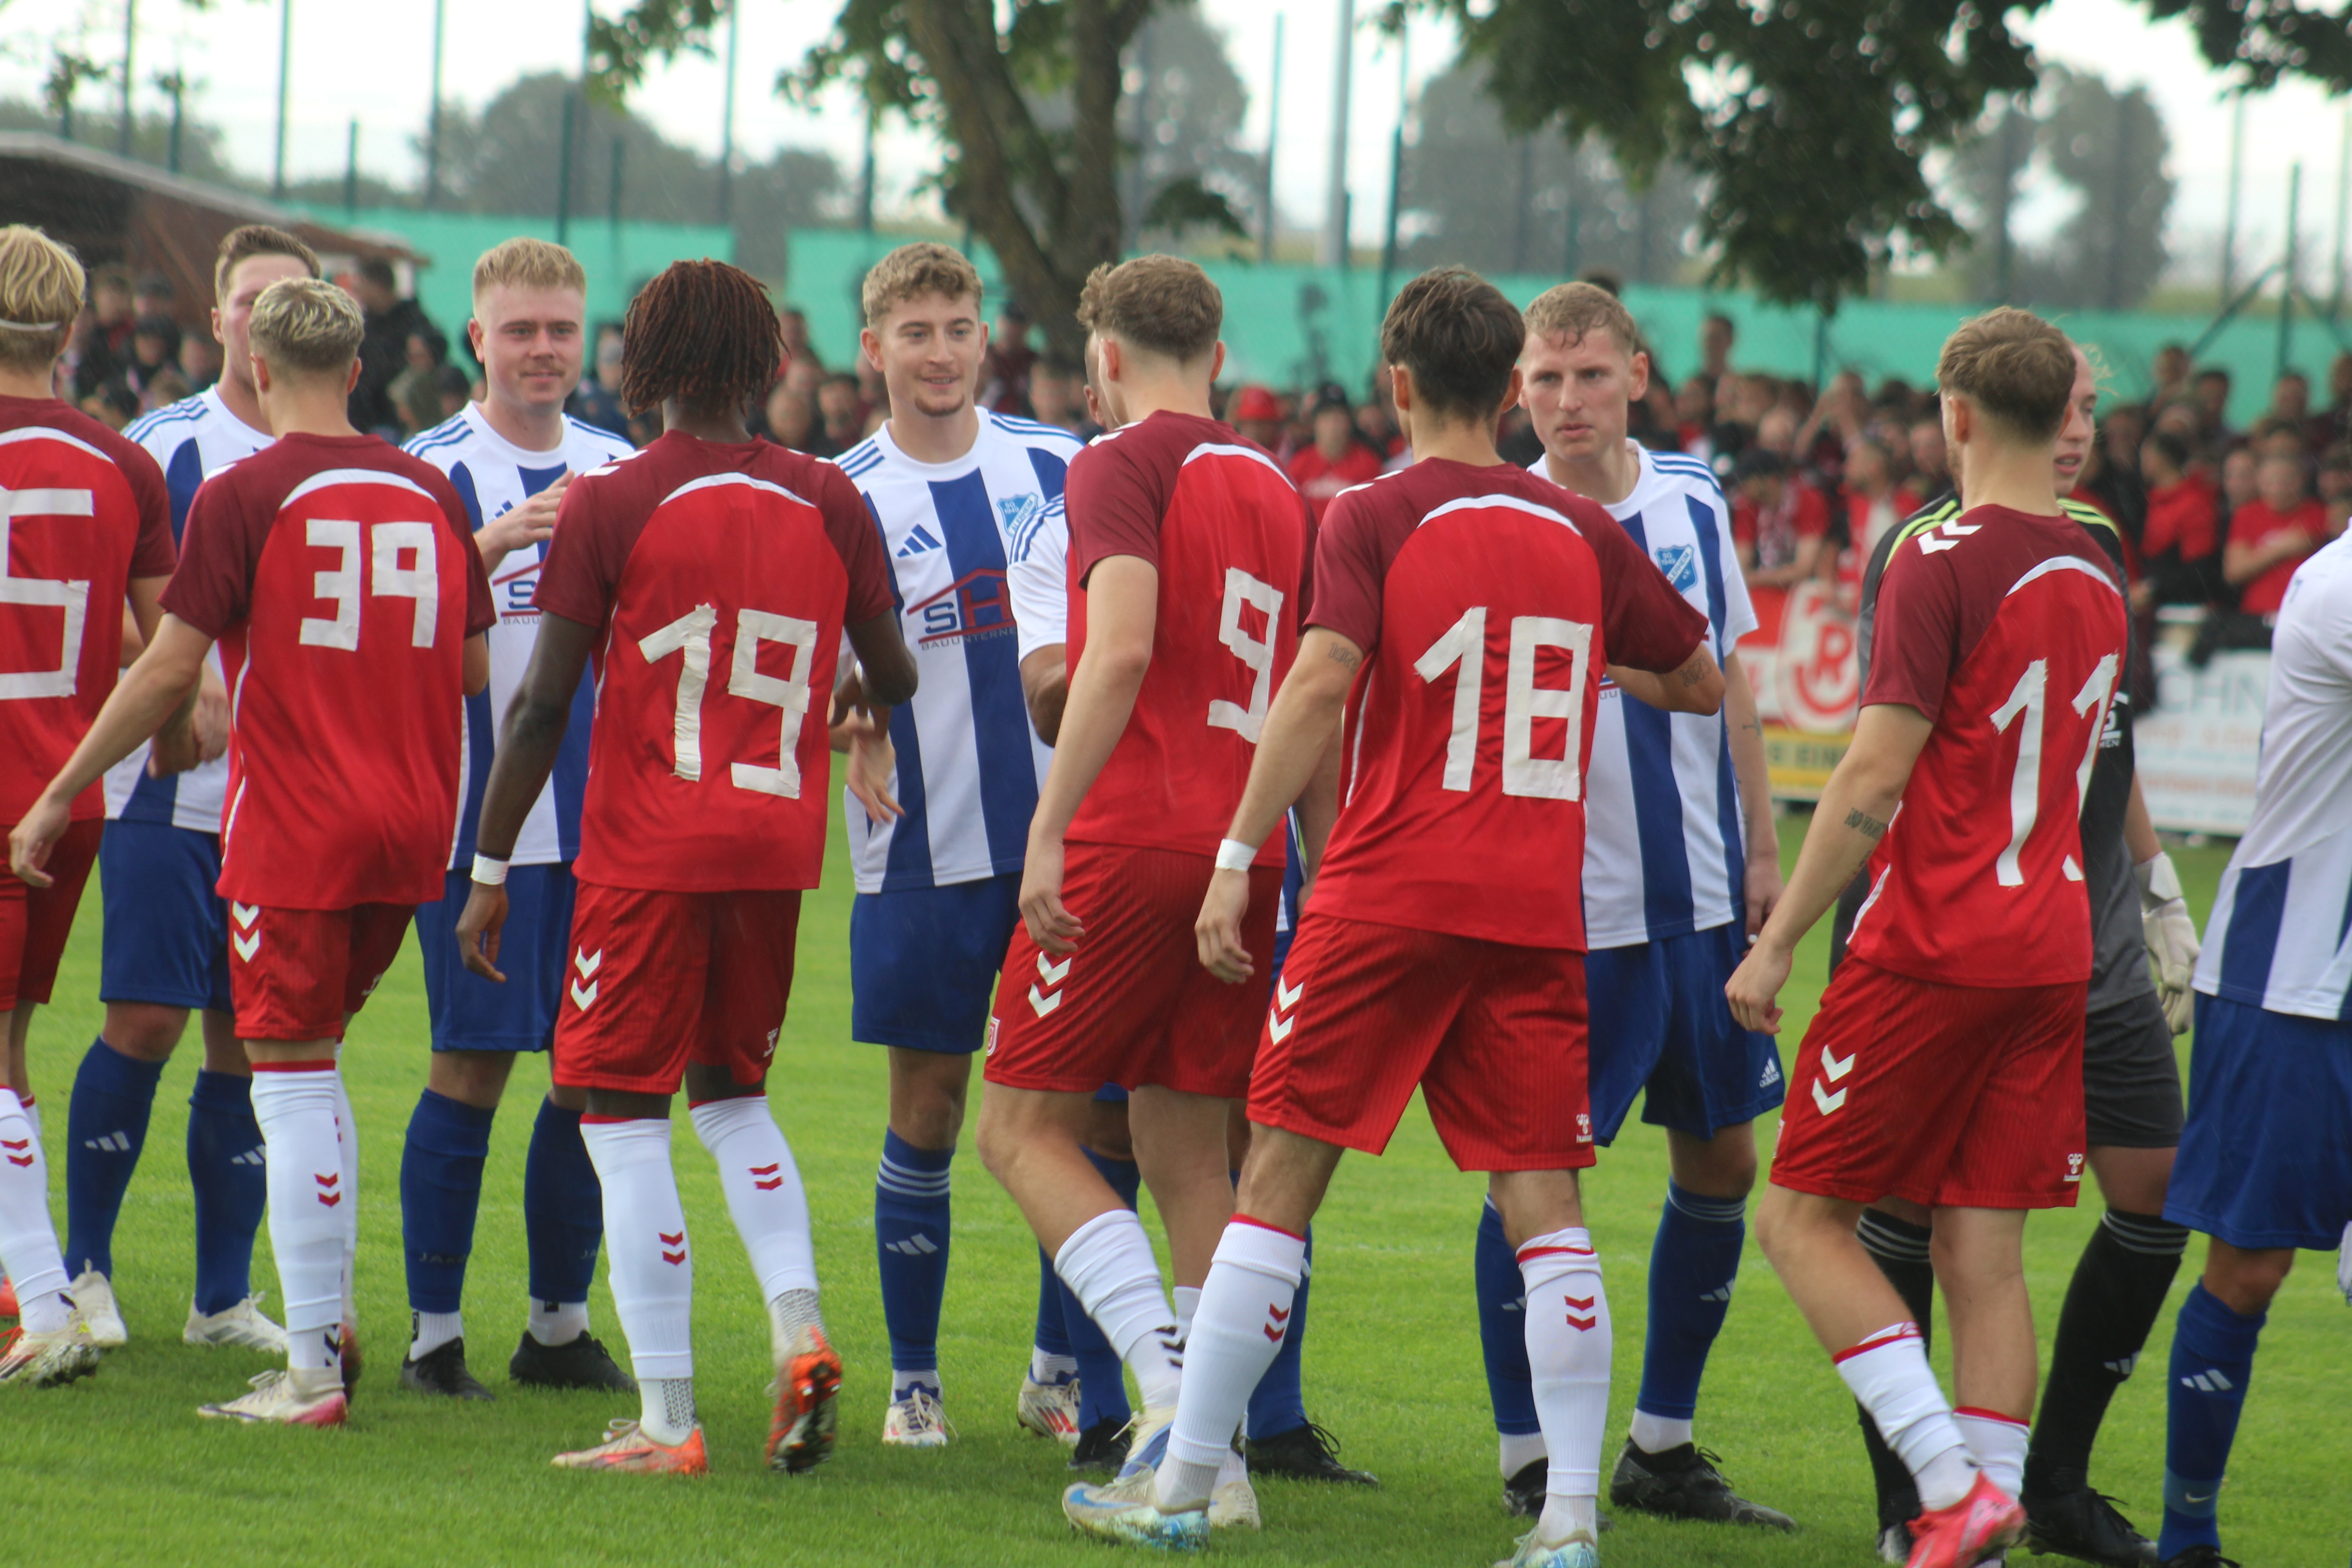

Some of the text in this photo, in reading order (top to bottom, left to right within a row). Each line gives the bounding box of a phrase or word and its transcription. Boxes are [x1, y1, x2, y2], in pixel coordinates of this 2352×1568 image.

[299, 519, 439, 652] 39
[1207, 567, 1284, 744] 9
[638, 602, 817, 800] 19
[1413, 606, 1593, 802] 18
[1989, 647, 2119, 887] 11
